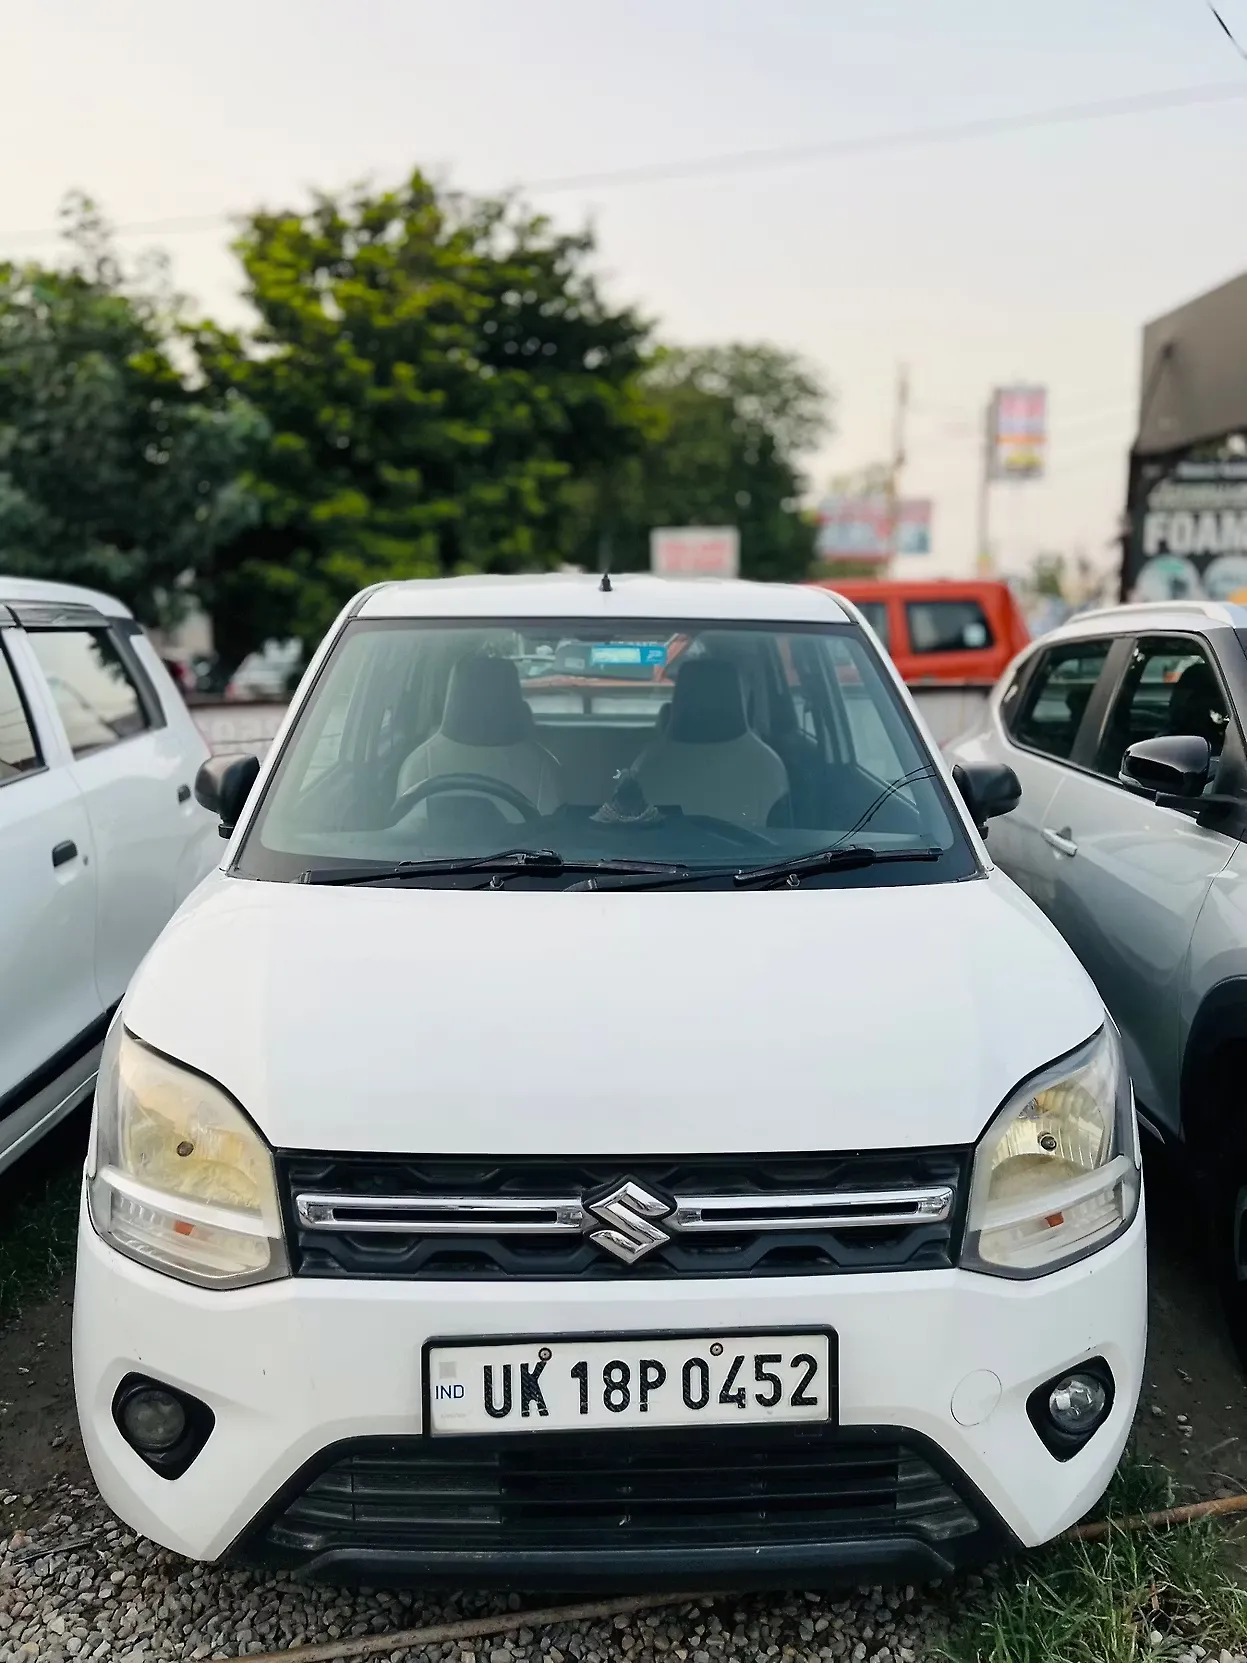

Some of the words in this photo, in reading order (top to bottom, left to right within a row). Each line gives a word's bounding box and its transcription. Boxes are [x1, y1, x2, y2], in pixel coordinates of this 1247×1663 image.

[435, 1384, 465, 1400] IND
[483, 1360, 549, 1418] UK
[570, 1359, 667, 1415] 18P
[682, 1353, 818, 1411] 0452
